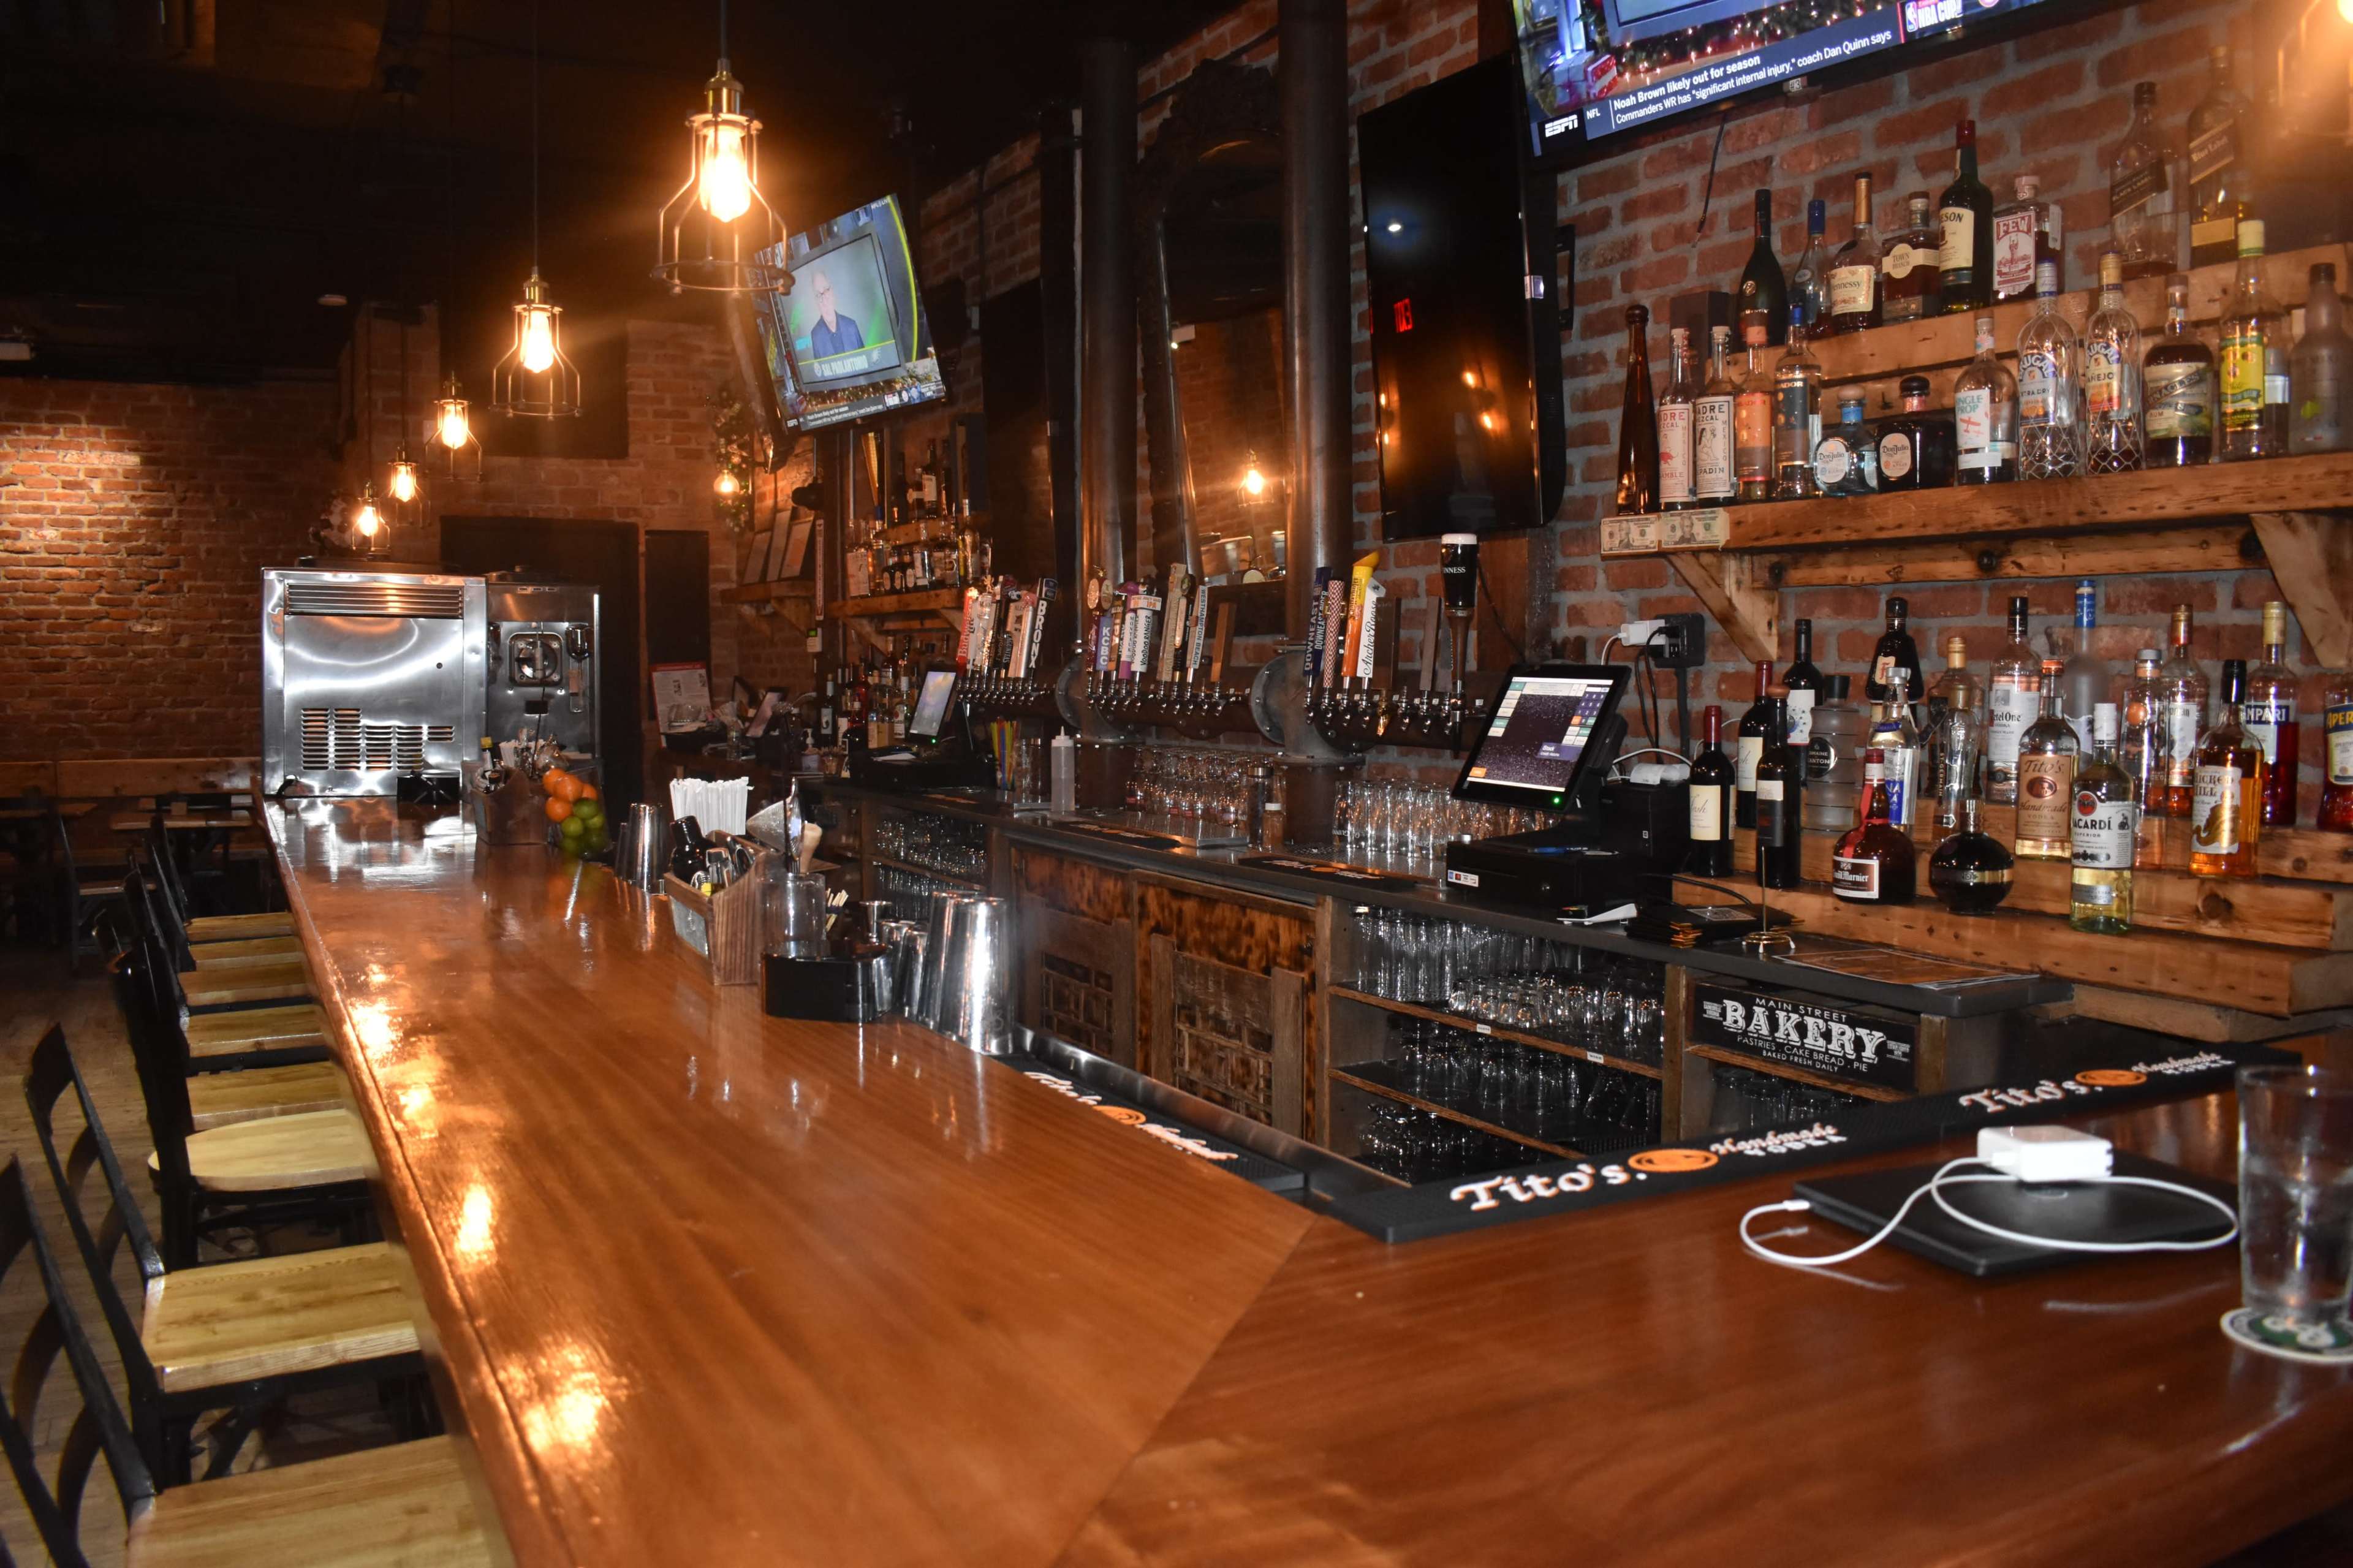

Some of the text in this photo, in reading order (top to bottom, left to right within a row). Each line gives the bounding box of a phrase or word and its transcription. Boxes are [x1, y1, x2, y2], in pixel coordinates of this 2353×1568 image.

[1917, 7, 1938, 28] NBA
[1613, 55, 1761, 111] Noah Brown likely out for season
[1616, 30, 1892, 124] Commanders WR has "significant internal injury," coach Dan Quinn says
[1790, 79, 1802, 91] #3
[1544, 114, 1579, 138] ESPN
[1586, 107, 1601, 120] NFL
[1999, 216, 2029, 236] FEW
[1832, 280, 1862, 292] ennessy
[1029, 600, 1048, 669] BRONX
[1192, 588, 1207, 667] WESTHAMPTON BEACH
[1305, 600, 1319, 671] DOWNEAST
[1314, 613, 1327, 650] DOWNEAST
[1099, 626, 1111, 665] KCBC
[1140, 640, 1149, 666] VOODOO
[1992, 711, 2004, 722] etel
[2024, 759, 2065, 773] Tito's
[2020, 800, 2068, 812] Handmade
[1755, 998, 1847, 1023] MAIN STREET
[1722, 999, 1887, 1064] BAKERY
[1737, 1034, 1868, 1072] PASTRIES CAKE BREAD PIE
[1762, 1050, 1838, 1073] BAKED FRESH DAILY
[1958, 1079, 2090, 1113] Tito's
[1449, 1122, 1838, 1212] Tito's Handmade
